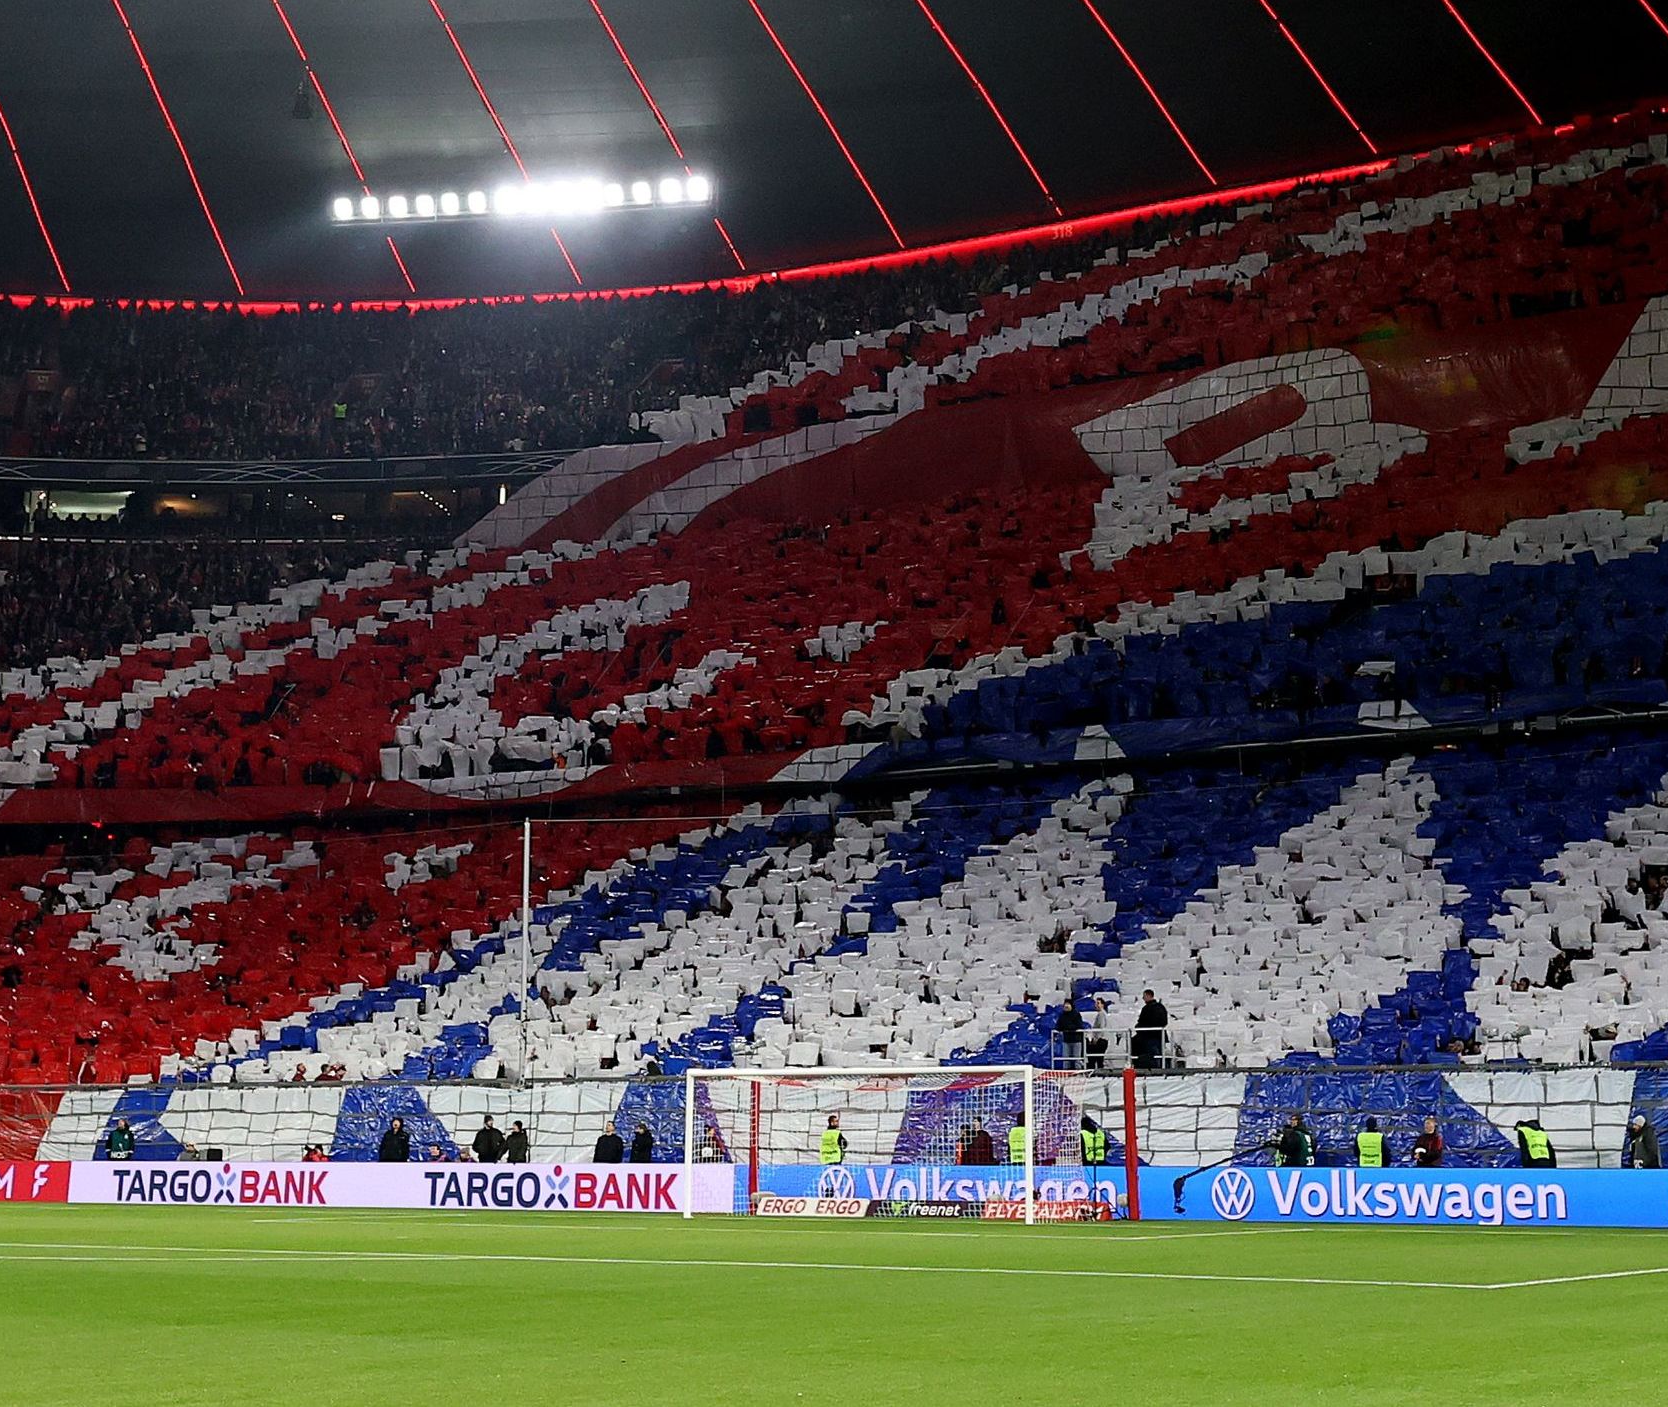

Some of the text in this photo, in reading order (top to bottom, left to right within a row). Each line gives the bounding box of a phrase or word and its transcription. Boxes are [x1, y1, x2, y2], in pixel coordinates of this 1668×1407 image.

[1268, 1170, 1567, 1225] Volkswagen
[763, 1199, 861, 1214] ERGO ERGO
[908, 1202, 961, 1217] freenet
